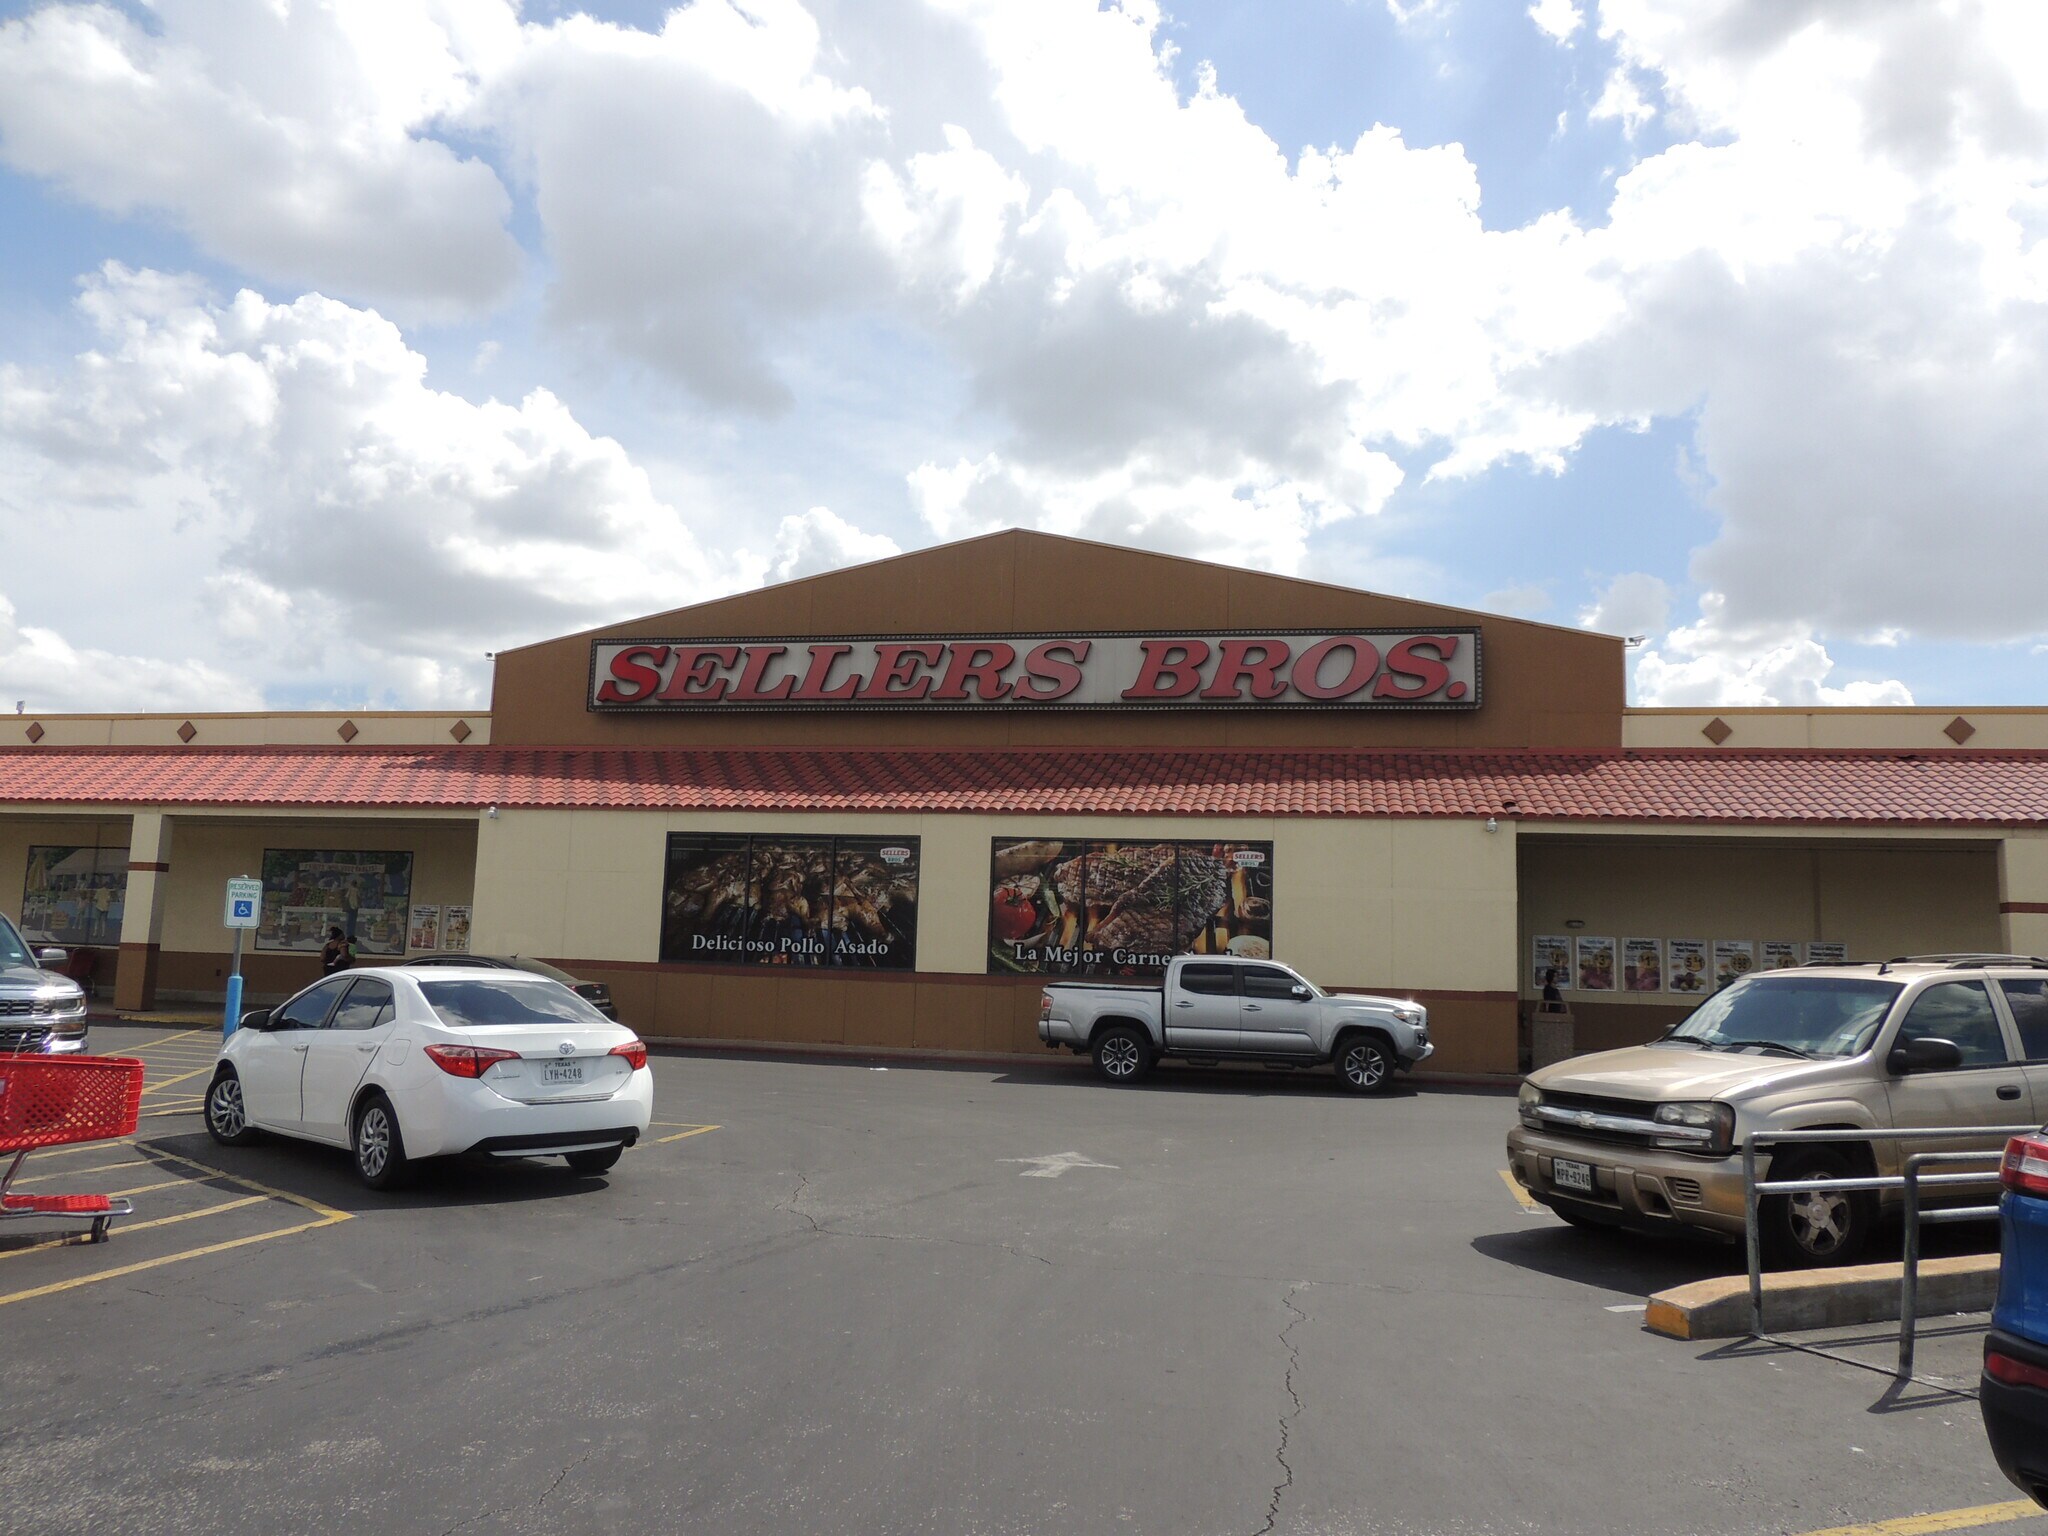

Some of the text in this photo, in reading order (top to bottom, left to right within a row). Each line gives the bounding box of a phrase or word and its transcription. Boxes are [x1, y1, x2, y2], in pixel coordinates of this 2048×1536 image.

[595, 634, 1467, 702] SELLERS BROS.
[230, 883, 259, 891] RESERVED
[231, 891, 258, 899] PARKING
[692, 935, 889, 955] Delicioso Pollo Asado
[1015, 944, 1037, 960] La
[1044, 946, 1104, 967] Mejor
[1113, 949, 1170, 966] Carne
